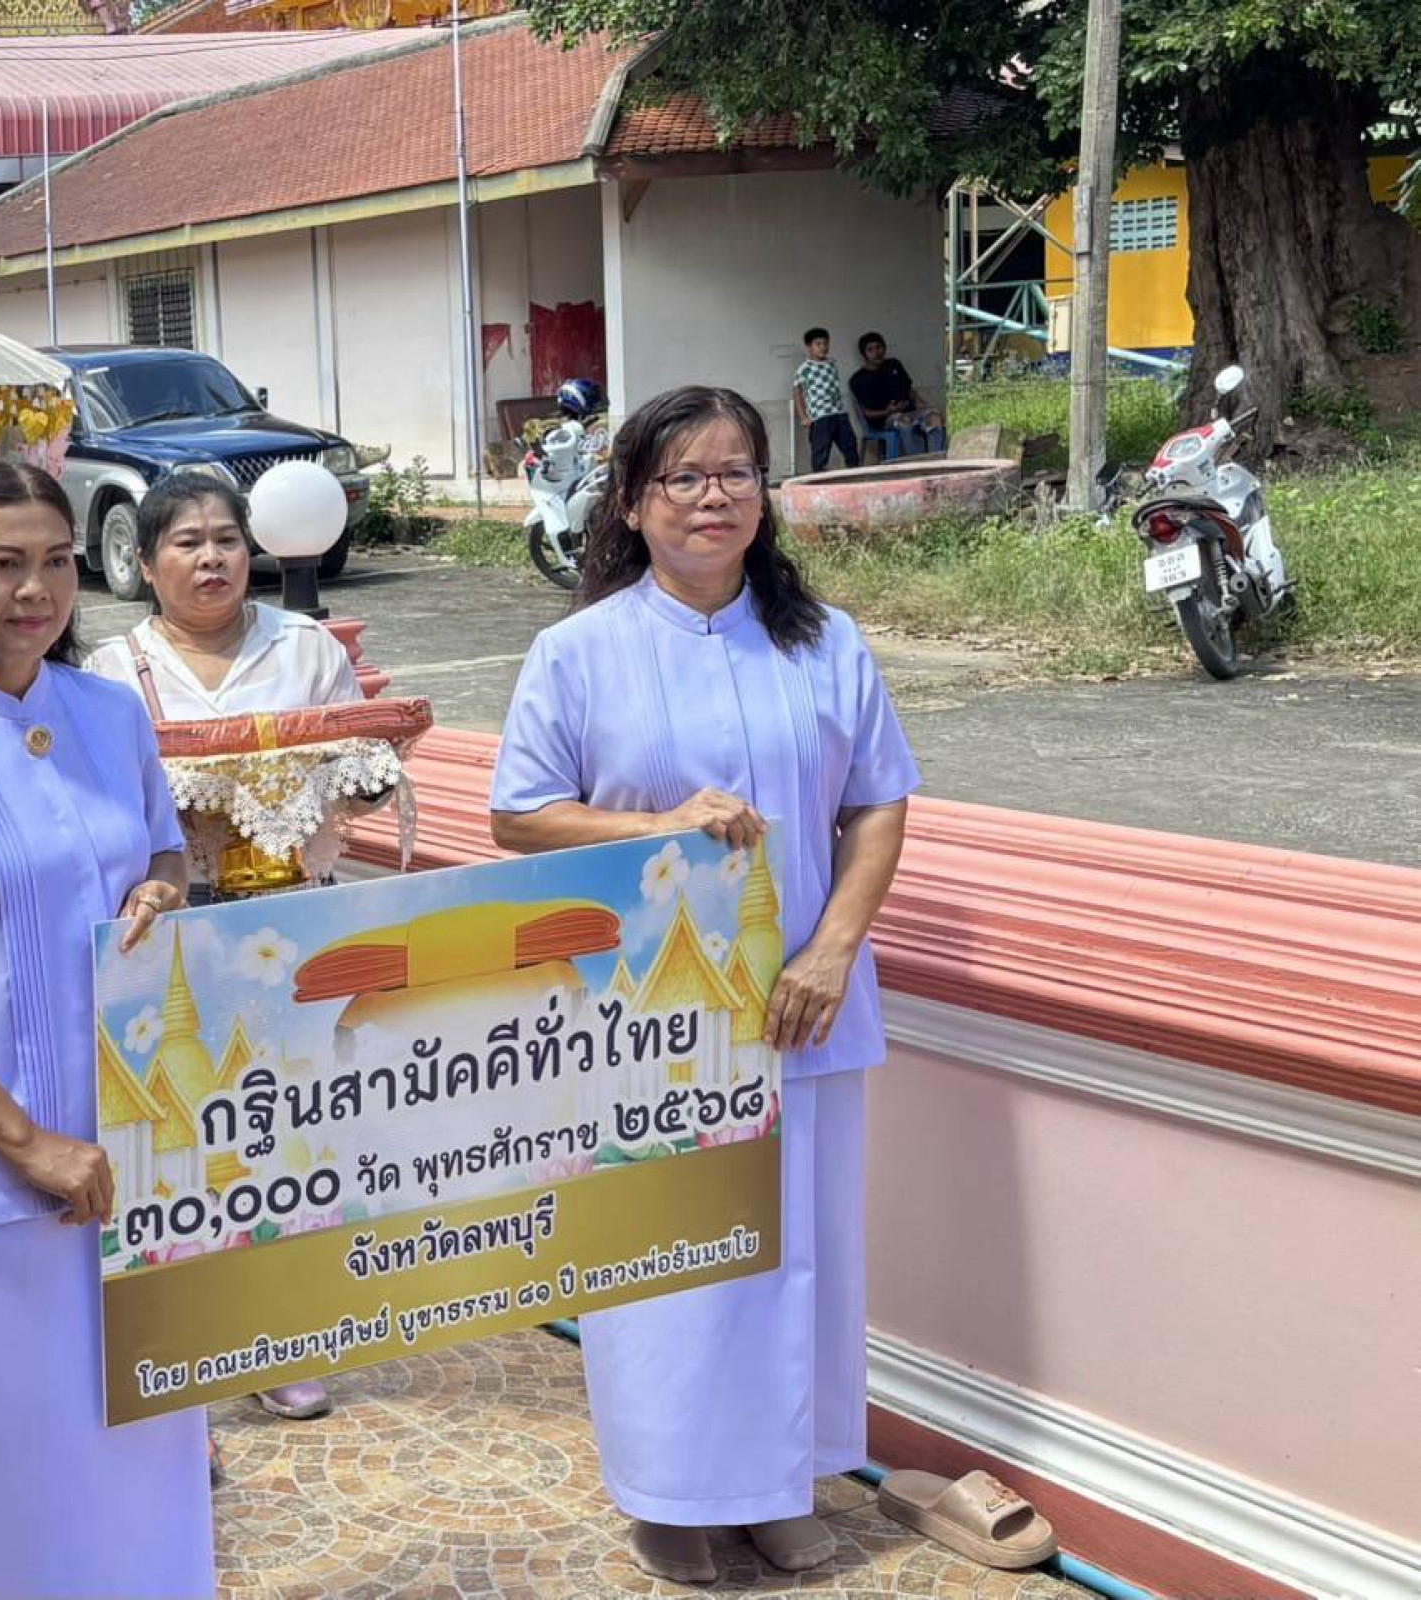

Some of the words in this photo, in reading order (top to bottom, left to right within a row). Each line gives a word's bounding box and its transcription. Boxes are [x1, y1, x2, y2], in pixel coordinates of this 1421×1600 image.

[201, 995, 698, 1159] กฐินสามัคคีทั่วไทย
[125, 1168, 341, 1246] ๓๐,๐๐๐
[357, 1152, 401, 1195] วัด
[412, 1120, 599, 1198] พุทธศักราช
[613, 1075, 765, 1143] ๒๕๖๘
[346, 1193, 555, 1277] จังหวัดลพบุรี
[138, 1363, 185, 1395] โดย
[197, 1306, 390, 1381] คณะศิษยานุศิษย์
[398, 1289, 508, 1342] บูชาธรรม
[517, 1283, 551, 1306] ๘๑
[559, 1264, 575, 1295] ปี
